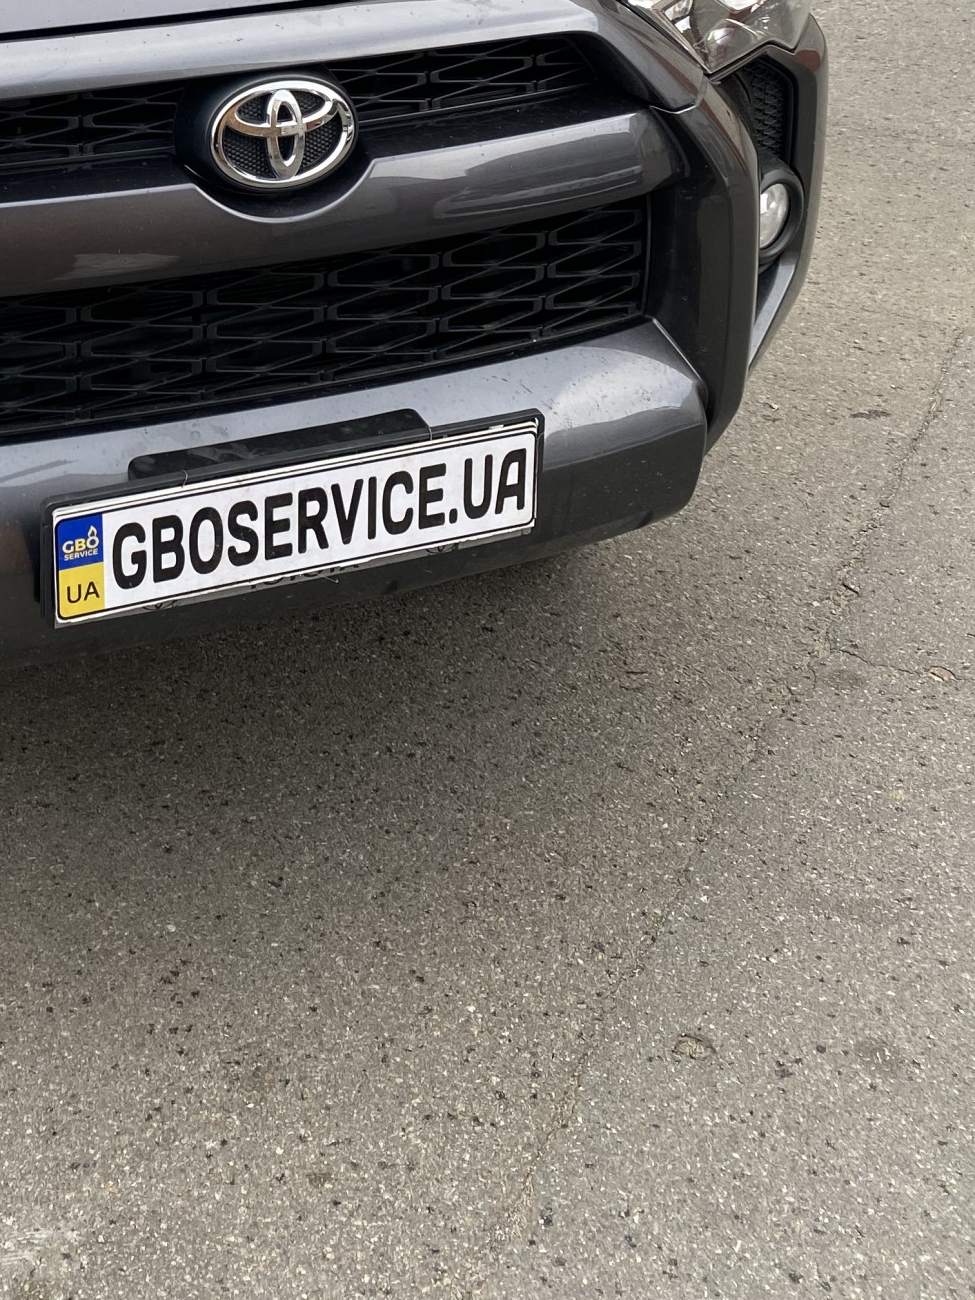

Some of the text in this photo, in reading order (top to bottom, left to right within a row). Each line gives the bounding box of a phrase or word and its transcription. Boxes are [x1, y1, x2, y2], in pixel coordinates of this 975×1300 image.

[112, 448, 527, 590] GBOSERVICE.UA
[62, 536, 100, 554] GBO
[63, 548, 98, 561] SERVICE
[66, 581, 100, 604] UA
